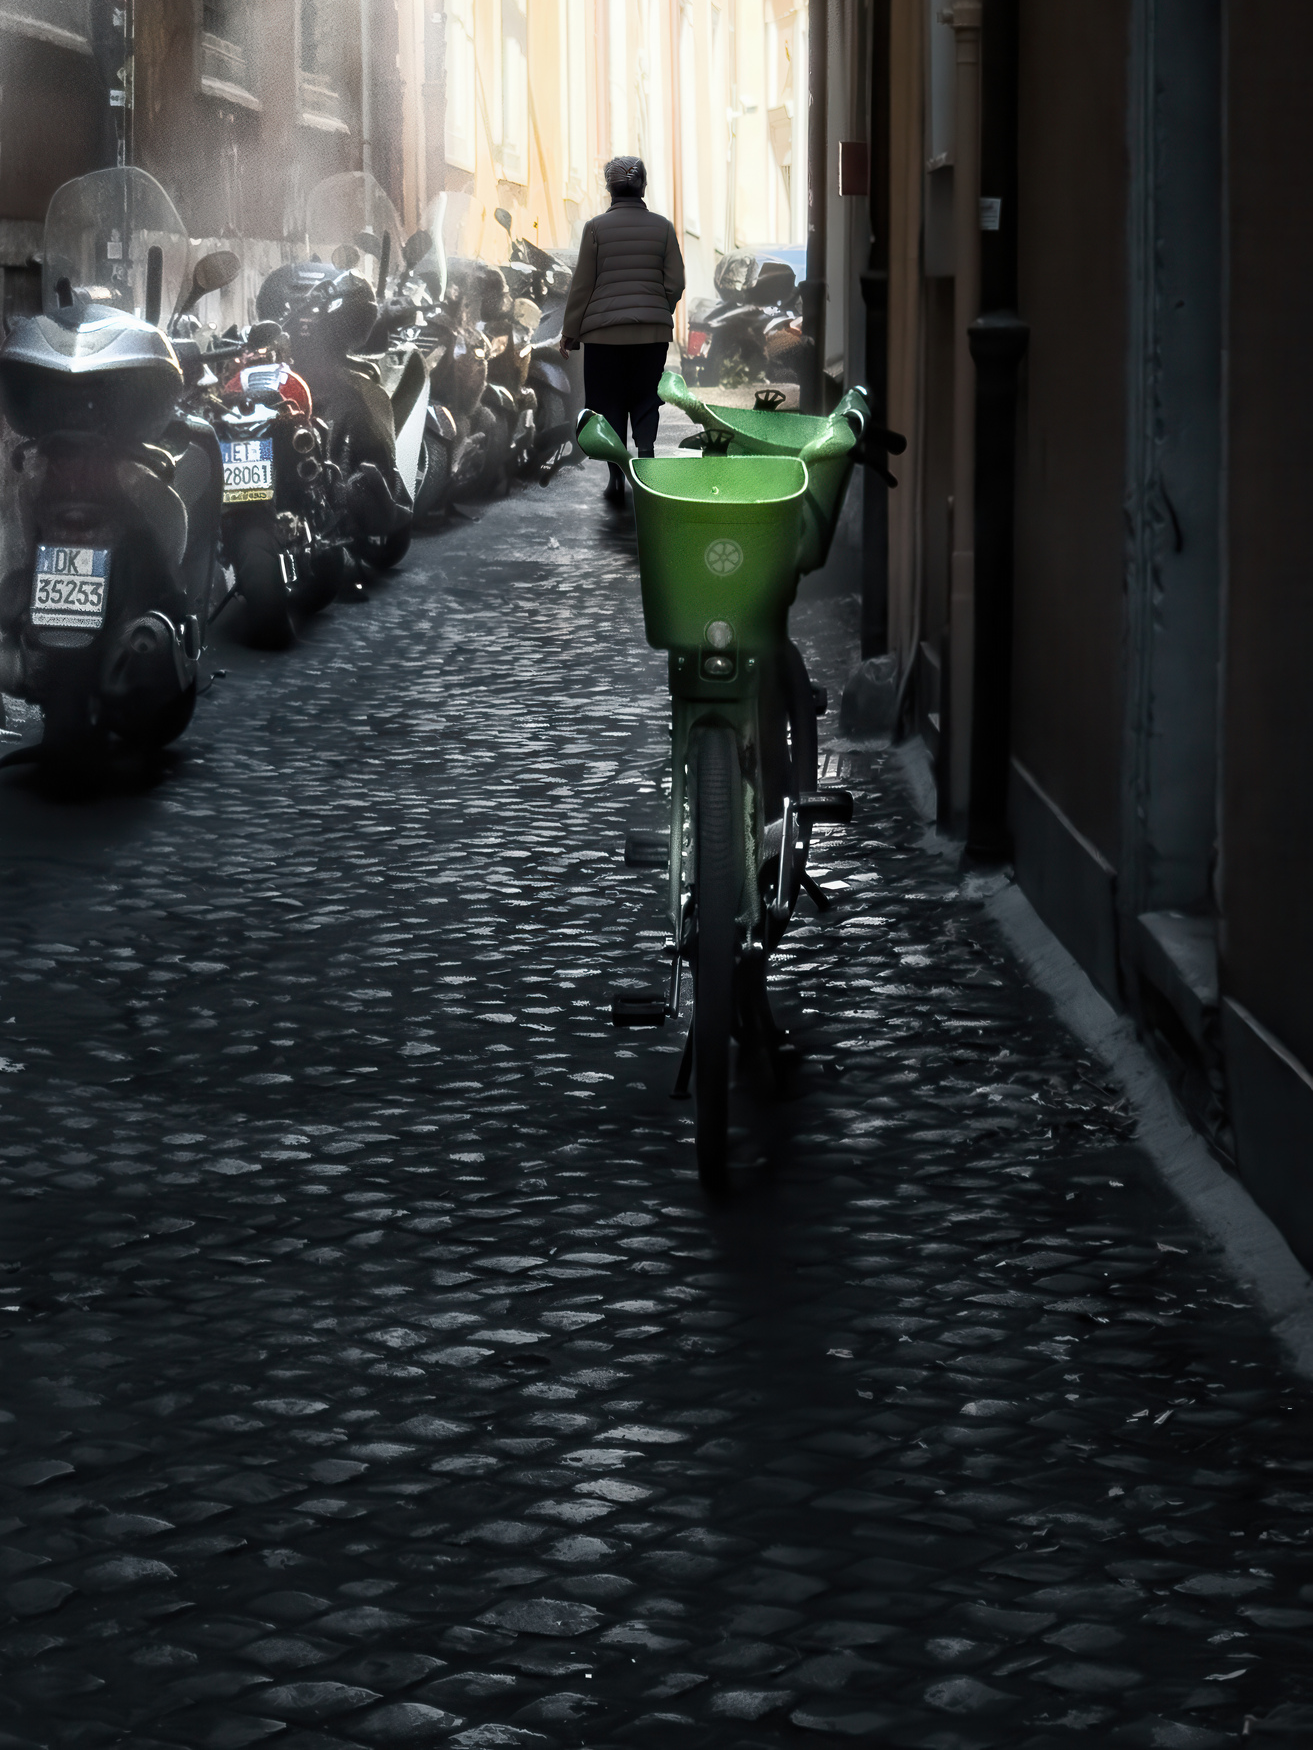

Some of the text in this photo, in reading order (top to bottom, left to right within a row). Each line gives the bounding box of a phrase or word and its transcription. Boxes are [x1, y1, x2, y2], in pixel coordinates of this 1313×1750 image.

[233, 442, 251, 462] ET
[224, 465, 268, 486] 28061
[55, 549, 81, 574] DK
[37, 578, 104, 607] 35253
